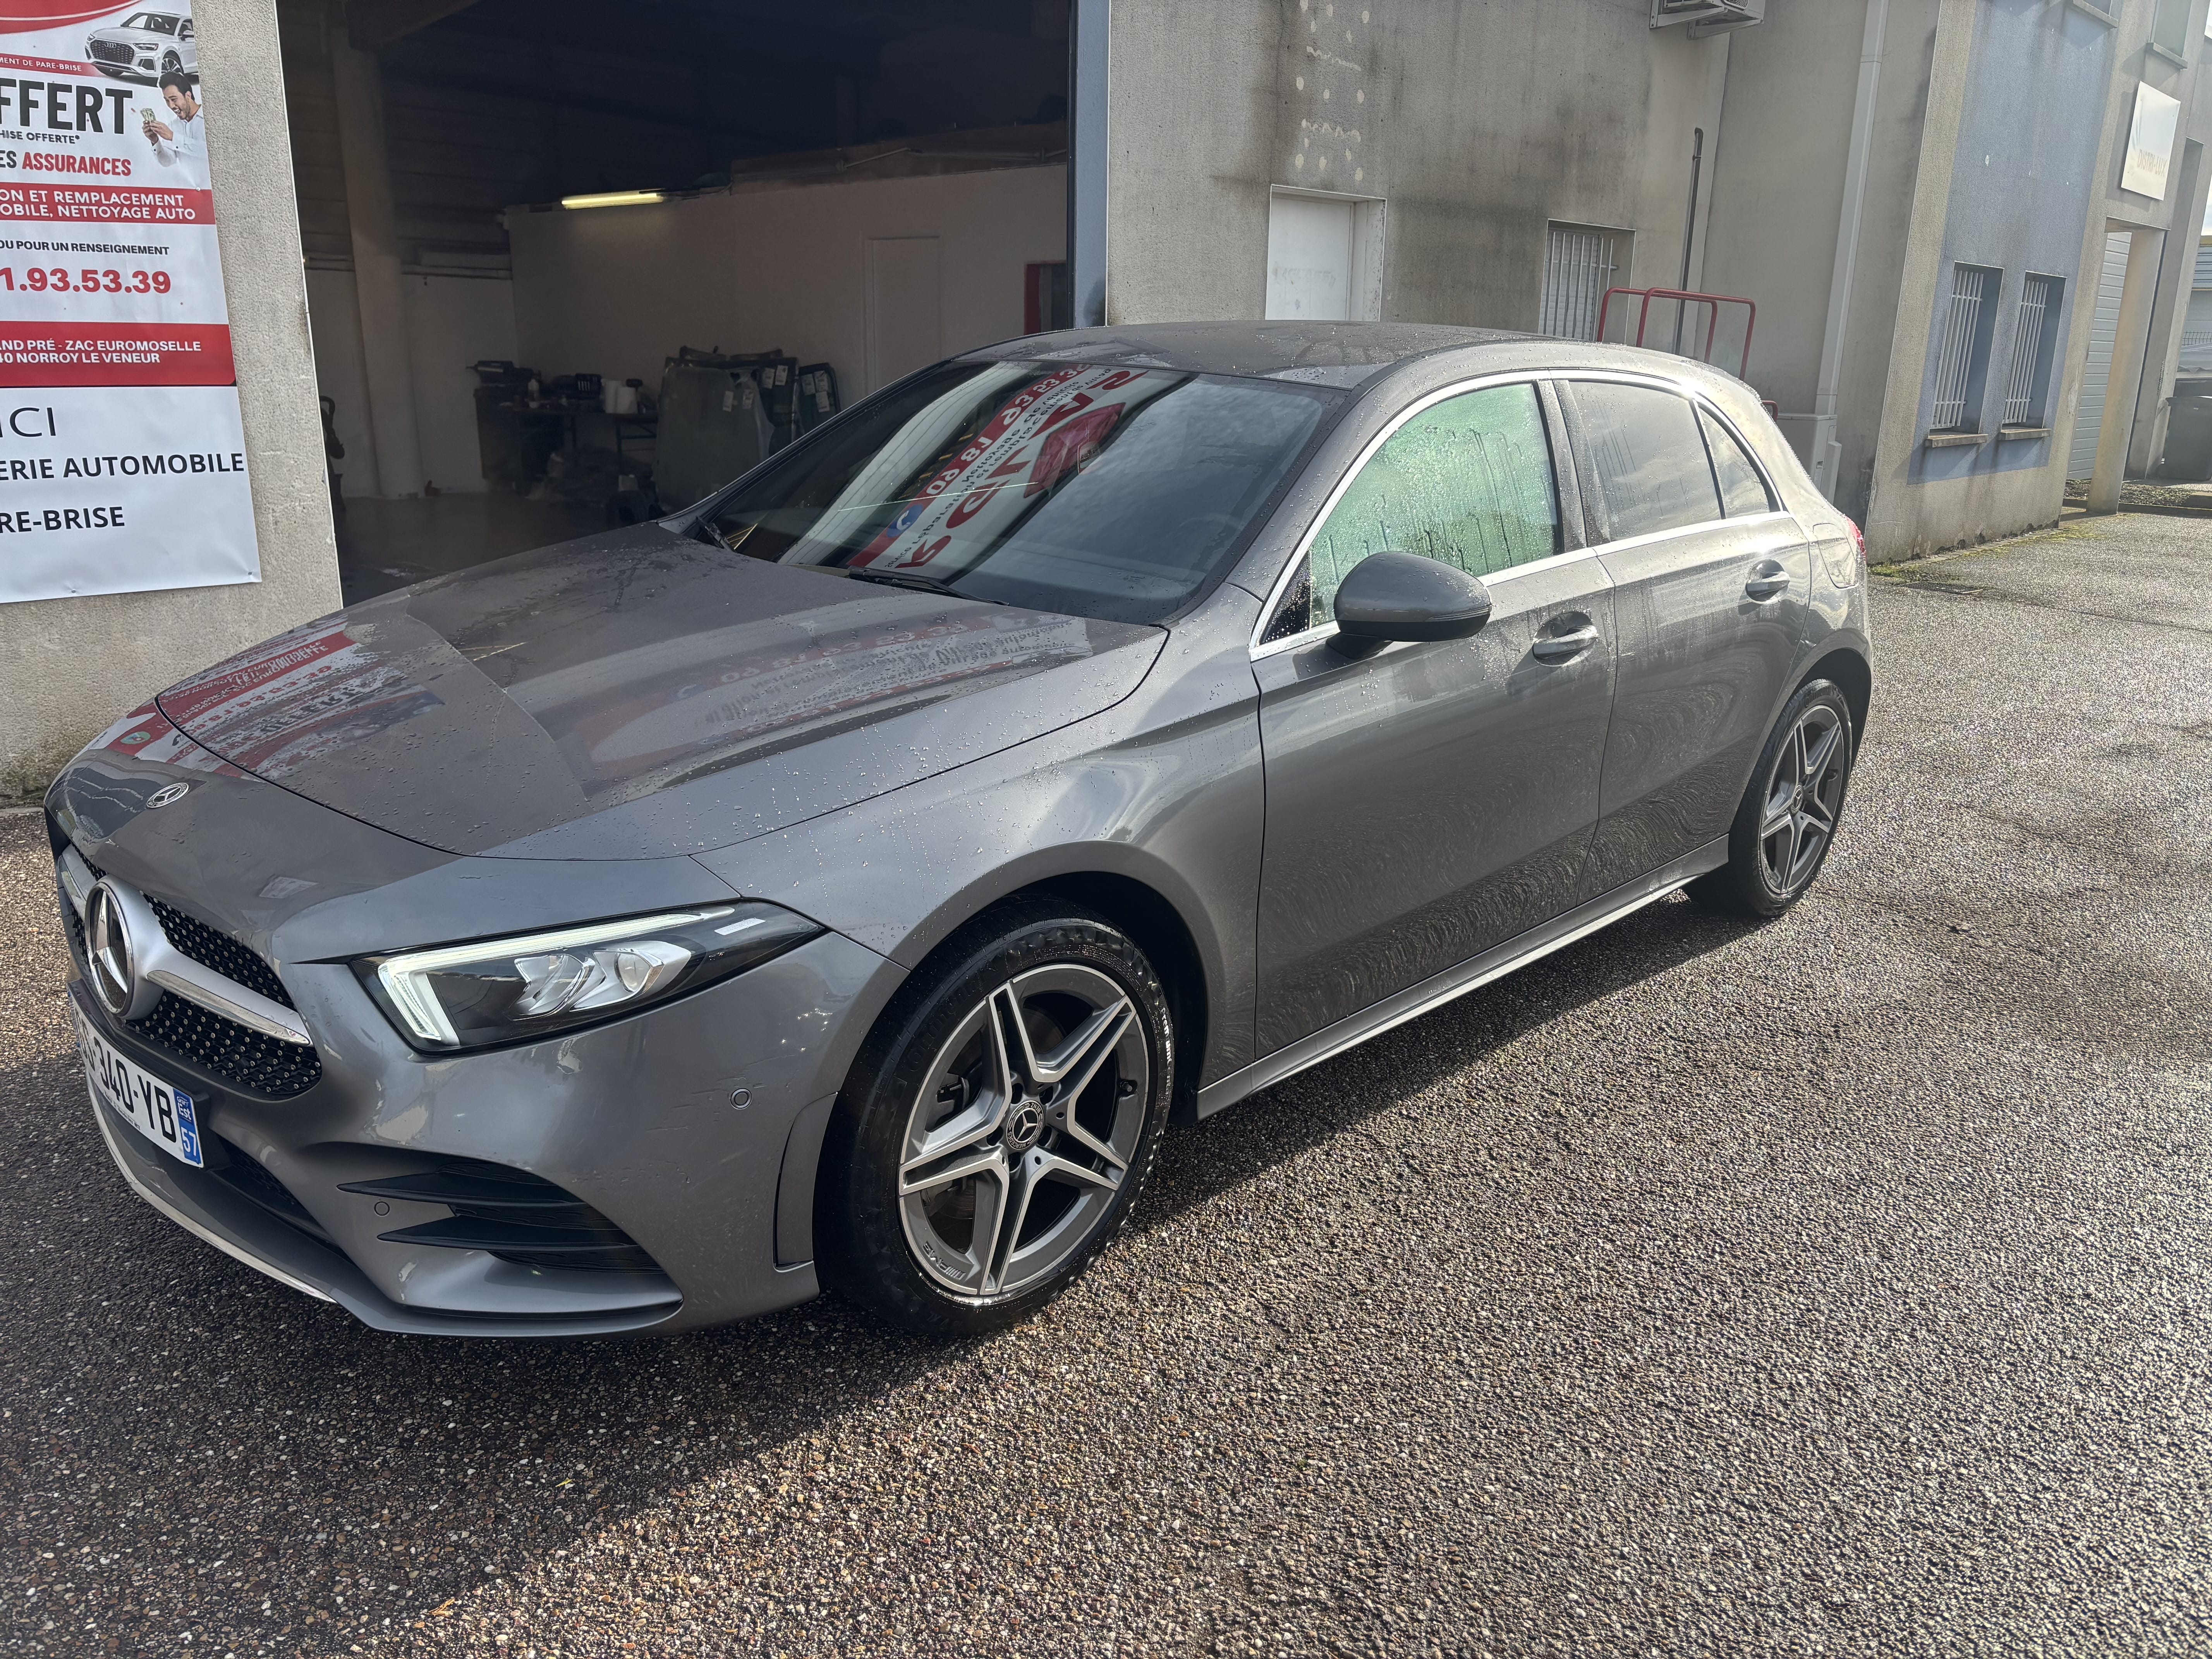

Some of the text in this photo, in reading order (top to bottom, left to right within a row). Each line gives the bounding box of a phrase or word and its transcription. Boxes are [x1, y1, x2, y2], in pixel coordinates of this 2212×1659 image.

[36, 61, 82, 71] PARE-BRISE
[0, 77, 133, 134] FFERT
[22, 152, 131, 176] ASSURANCES
[2137, 149, 2168, 177] DISTRI-LUX
[0, 189, 184, 206] ON ET REMPLACEMENT
[0, 203, 196, 220] OBILE, NETTOYAGE AUTO
[16, 240, 50, 251] POUR
[51, 242, 69, 251] UN
[71, 243, 169, 256] RENSEIGNEMENT
[0, 267, 171, 294] 1.93.53.39
[0, 340, 24, 350] ND
[27, 338, 56, 350] PRÉ
[65, 340, 94, 350] ZAC
[97, 340, 201, 351] EUROMOSELLE
[16, 353, 79, 363] NORROY
[82, 353, 100, 362] LE
[102, 353, 160, 363] VENEUR
[63, 453, 244, 478] AUTOMOBILE
[0, 506, 125, 533] RE-BRISE
[178, 1103, 192, 1120] Est
[181, 1127, 197, 1156] 57
